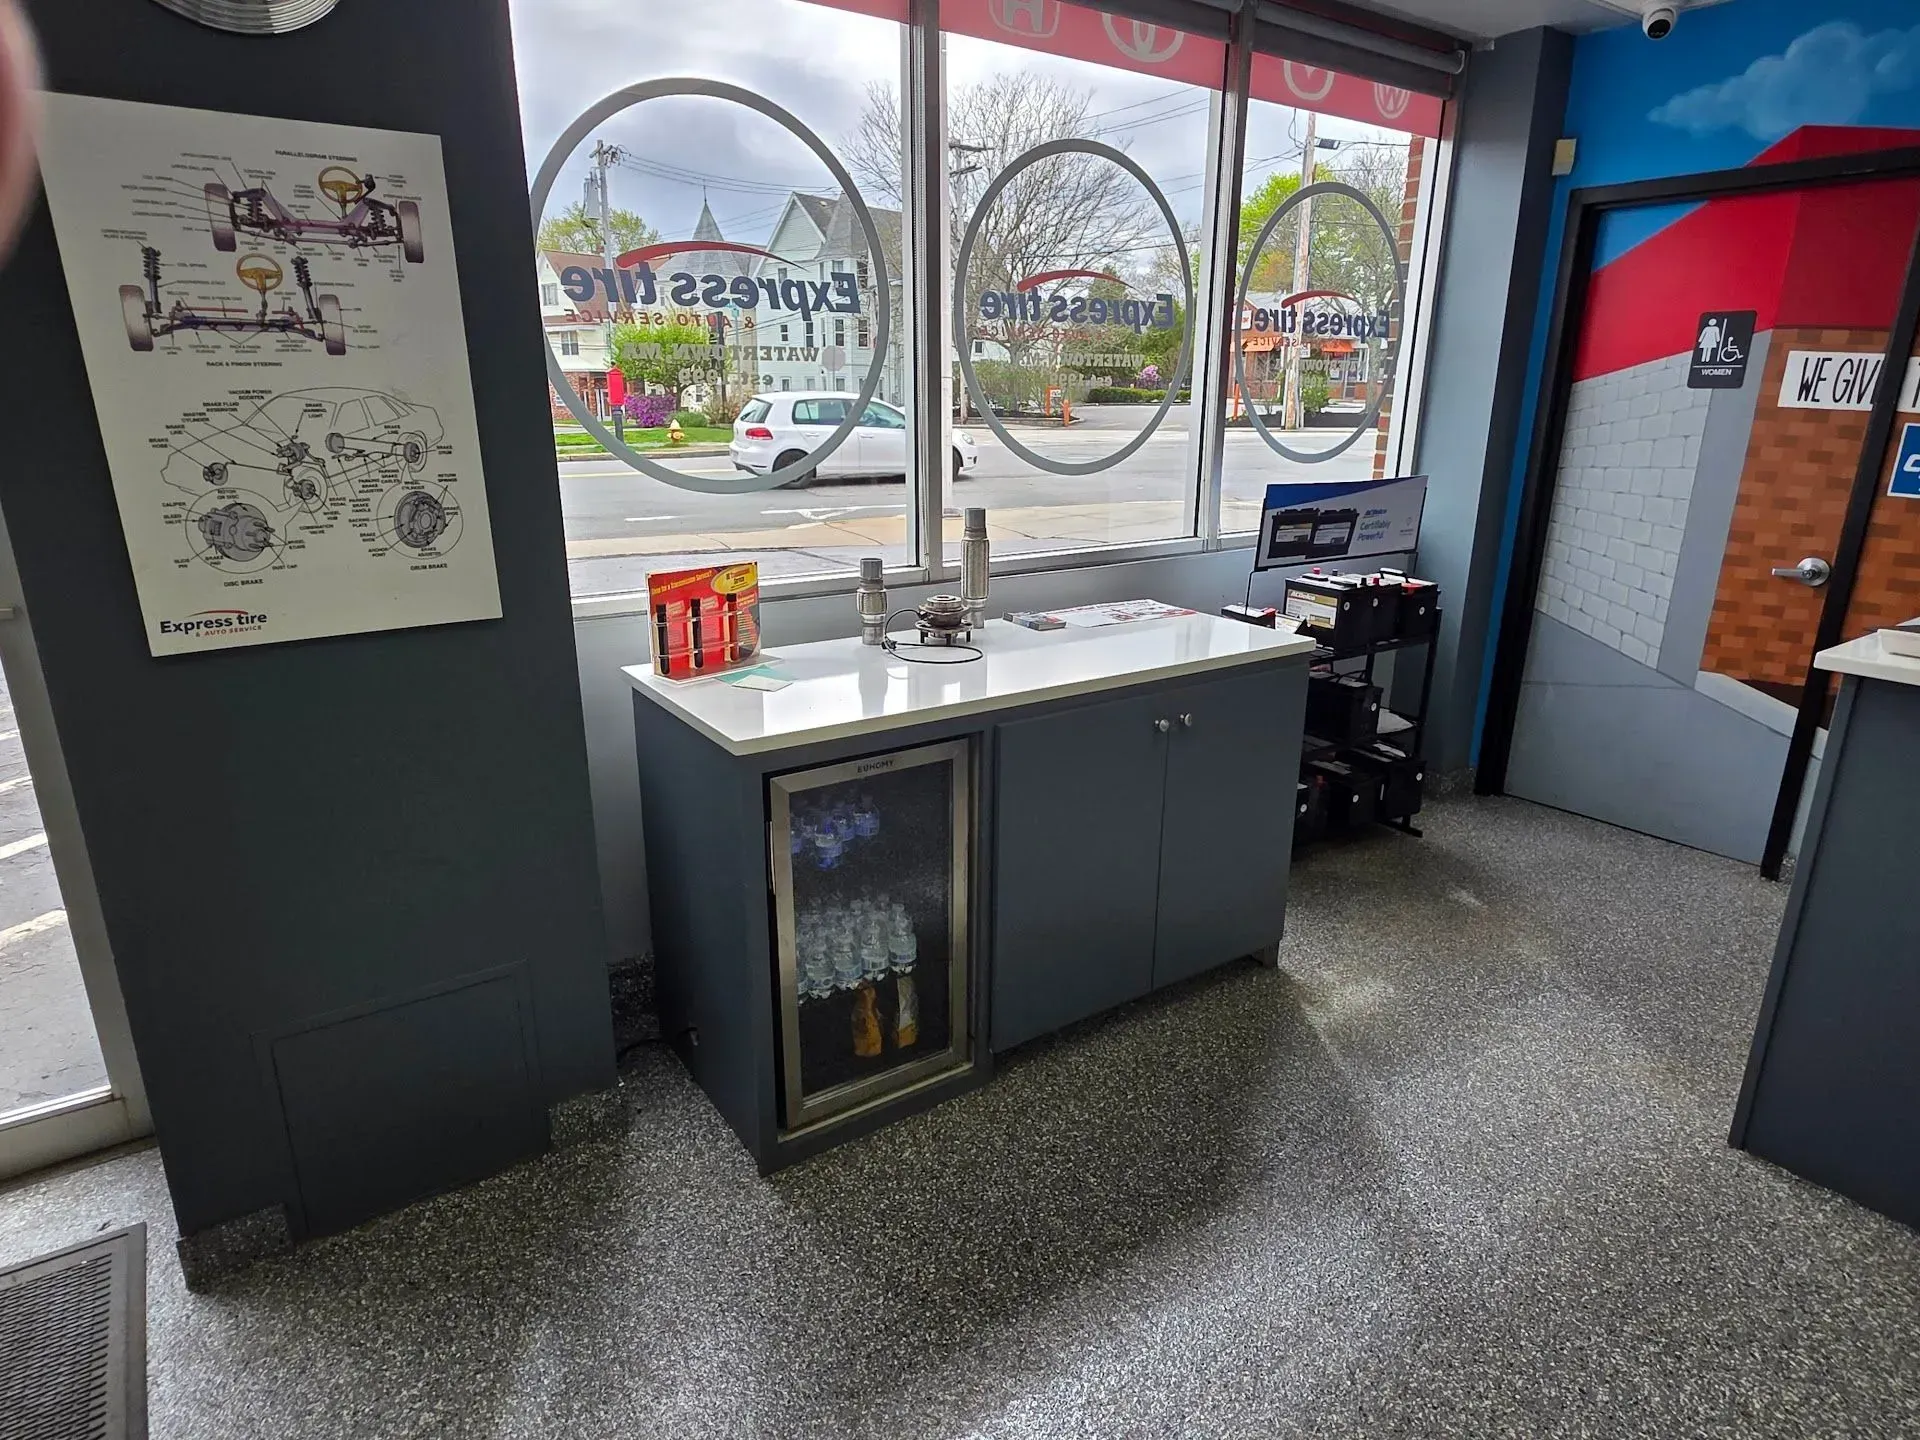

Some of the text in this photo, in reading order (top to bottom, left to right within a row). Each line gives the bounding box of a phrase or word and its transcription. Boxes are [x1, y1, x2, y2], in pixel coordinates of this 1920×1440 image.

[1701, 368, 1732, 376] WOMEN
[1797, 357, 1832, 403] WE
[1832, 358, 1881, 405] GIV
[160, 613, 267, 634] Express tire
[204, 628, 227, 636] AUTO
[229, 625, 262, 634] SERVICE
